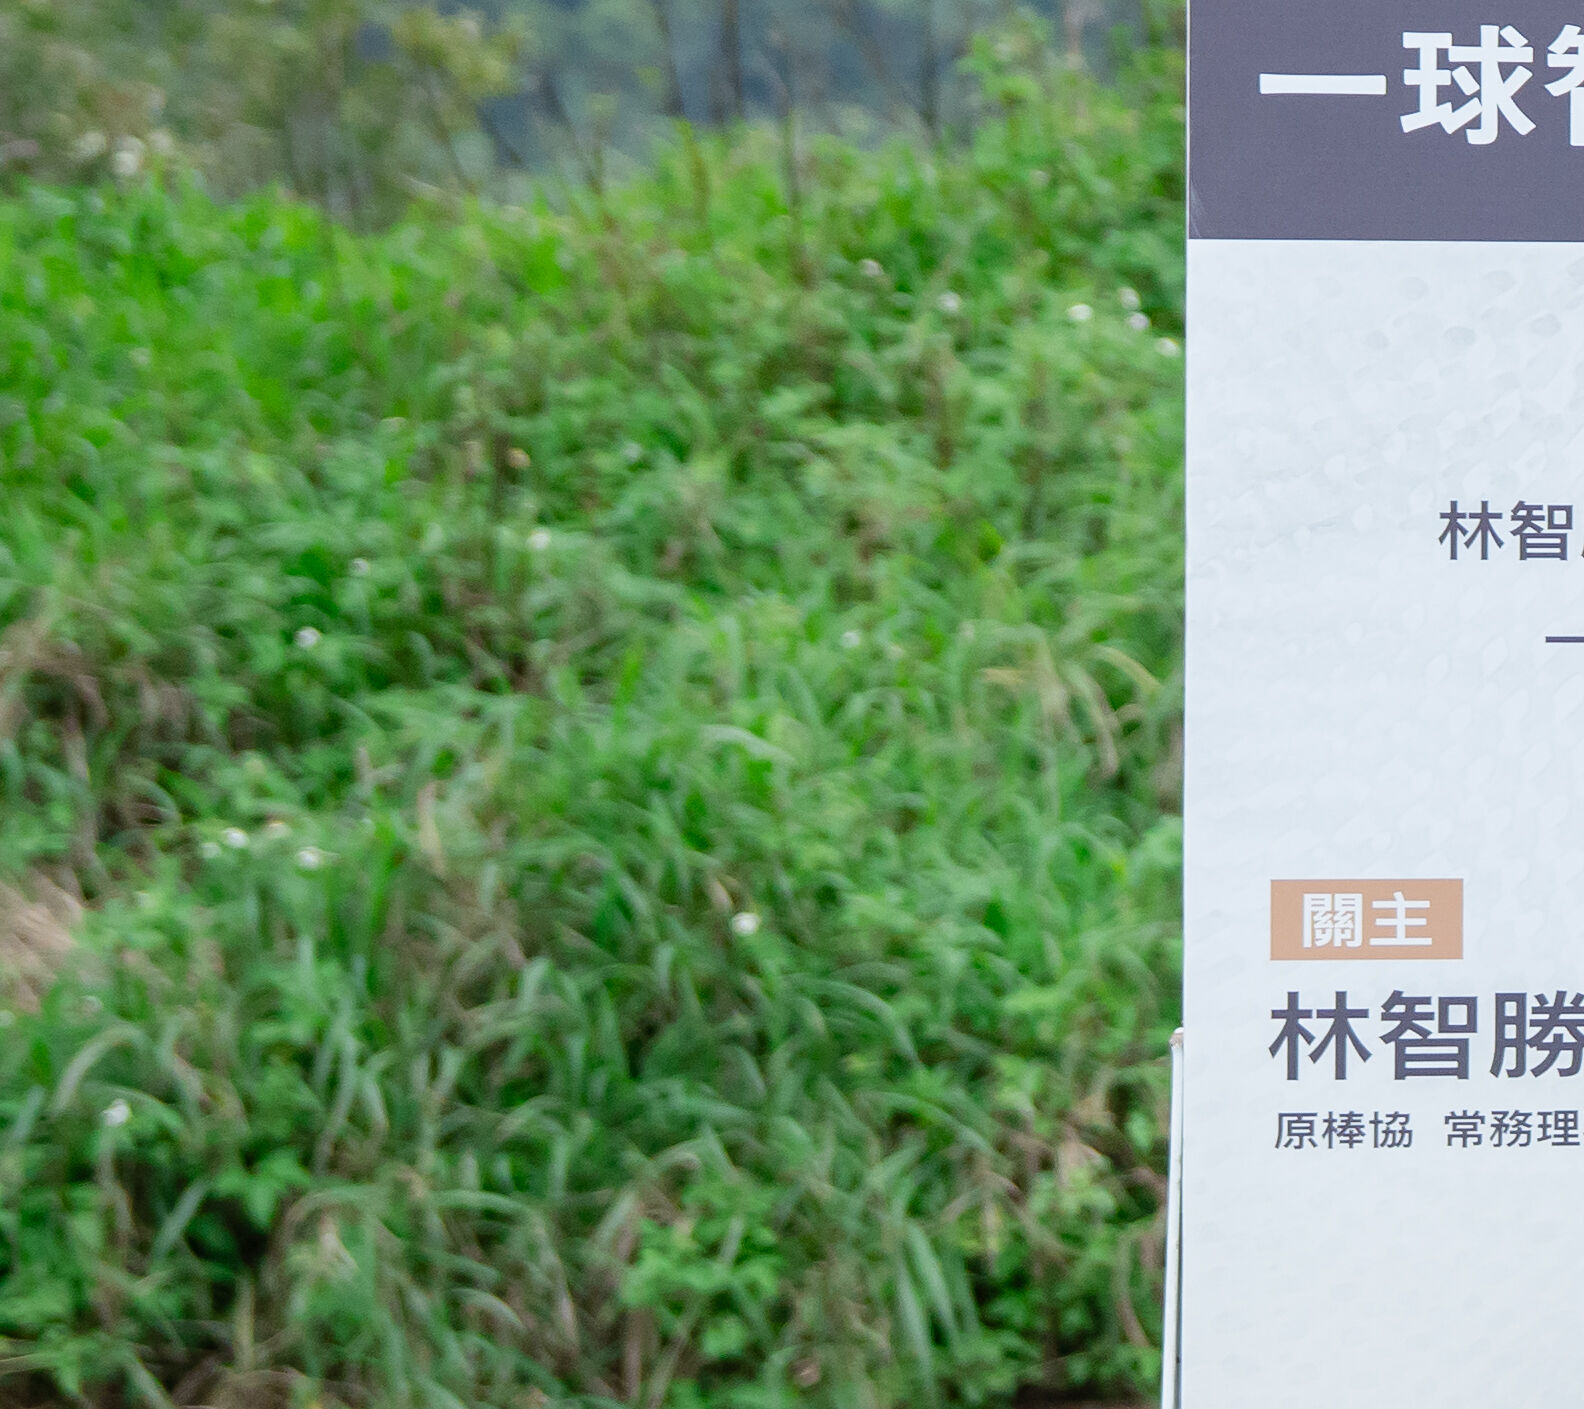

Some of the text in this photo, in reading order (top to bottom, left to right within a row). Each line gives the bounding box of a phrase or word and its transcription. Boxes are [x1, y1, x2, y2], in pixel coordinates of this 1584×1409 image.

[1301, 891, 1434, 949] 關主
[1273, 1110, 1414, 1150] 原棒協
